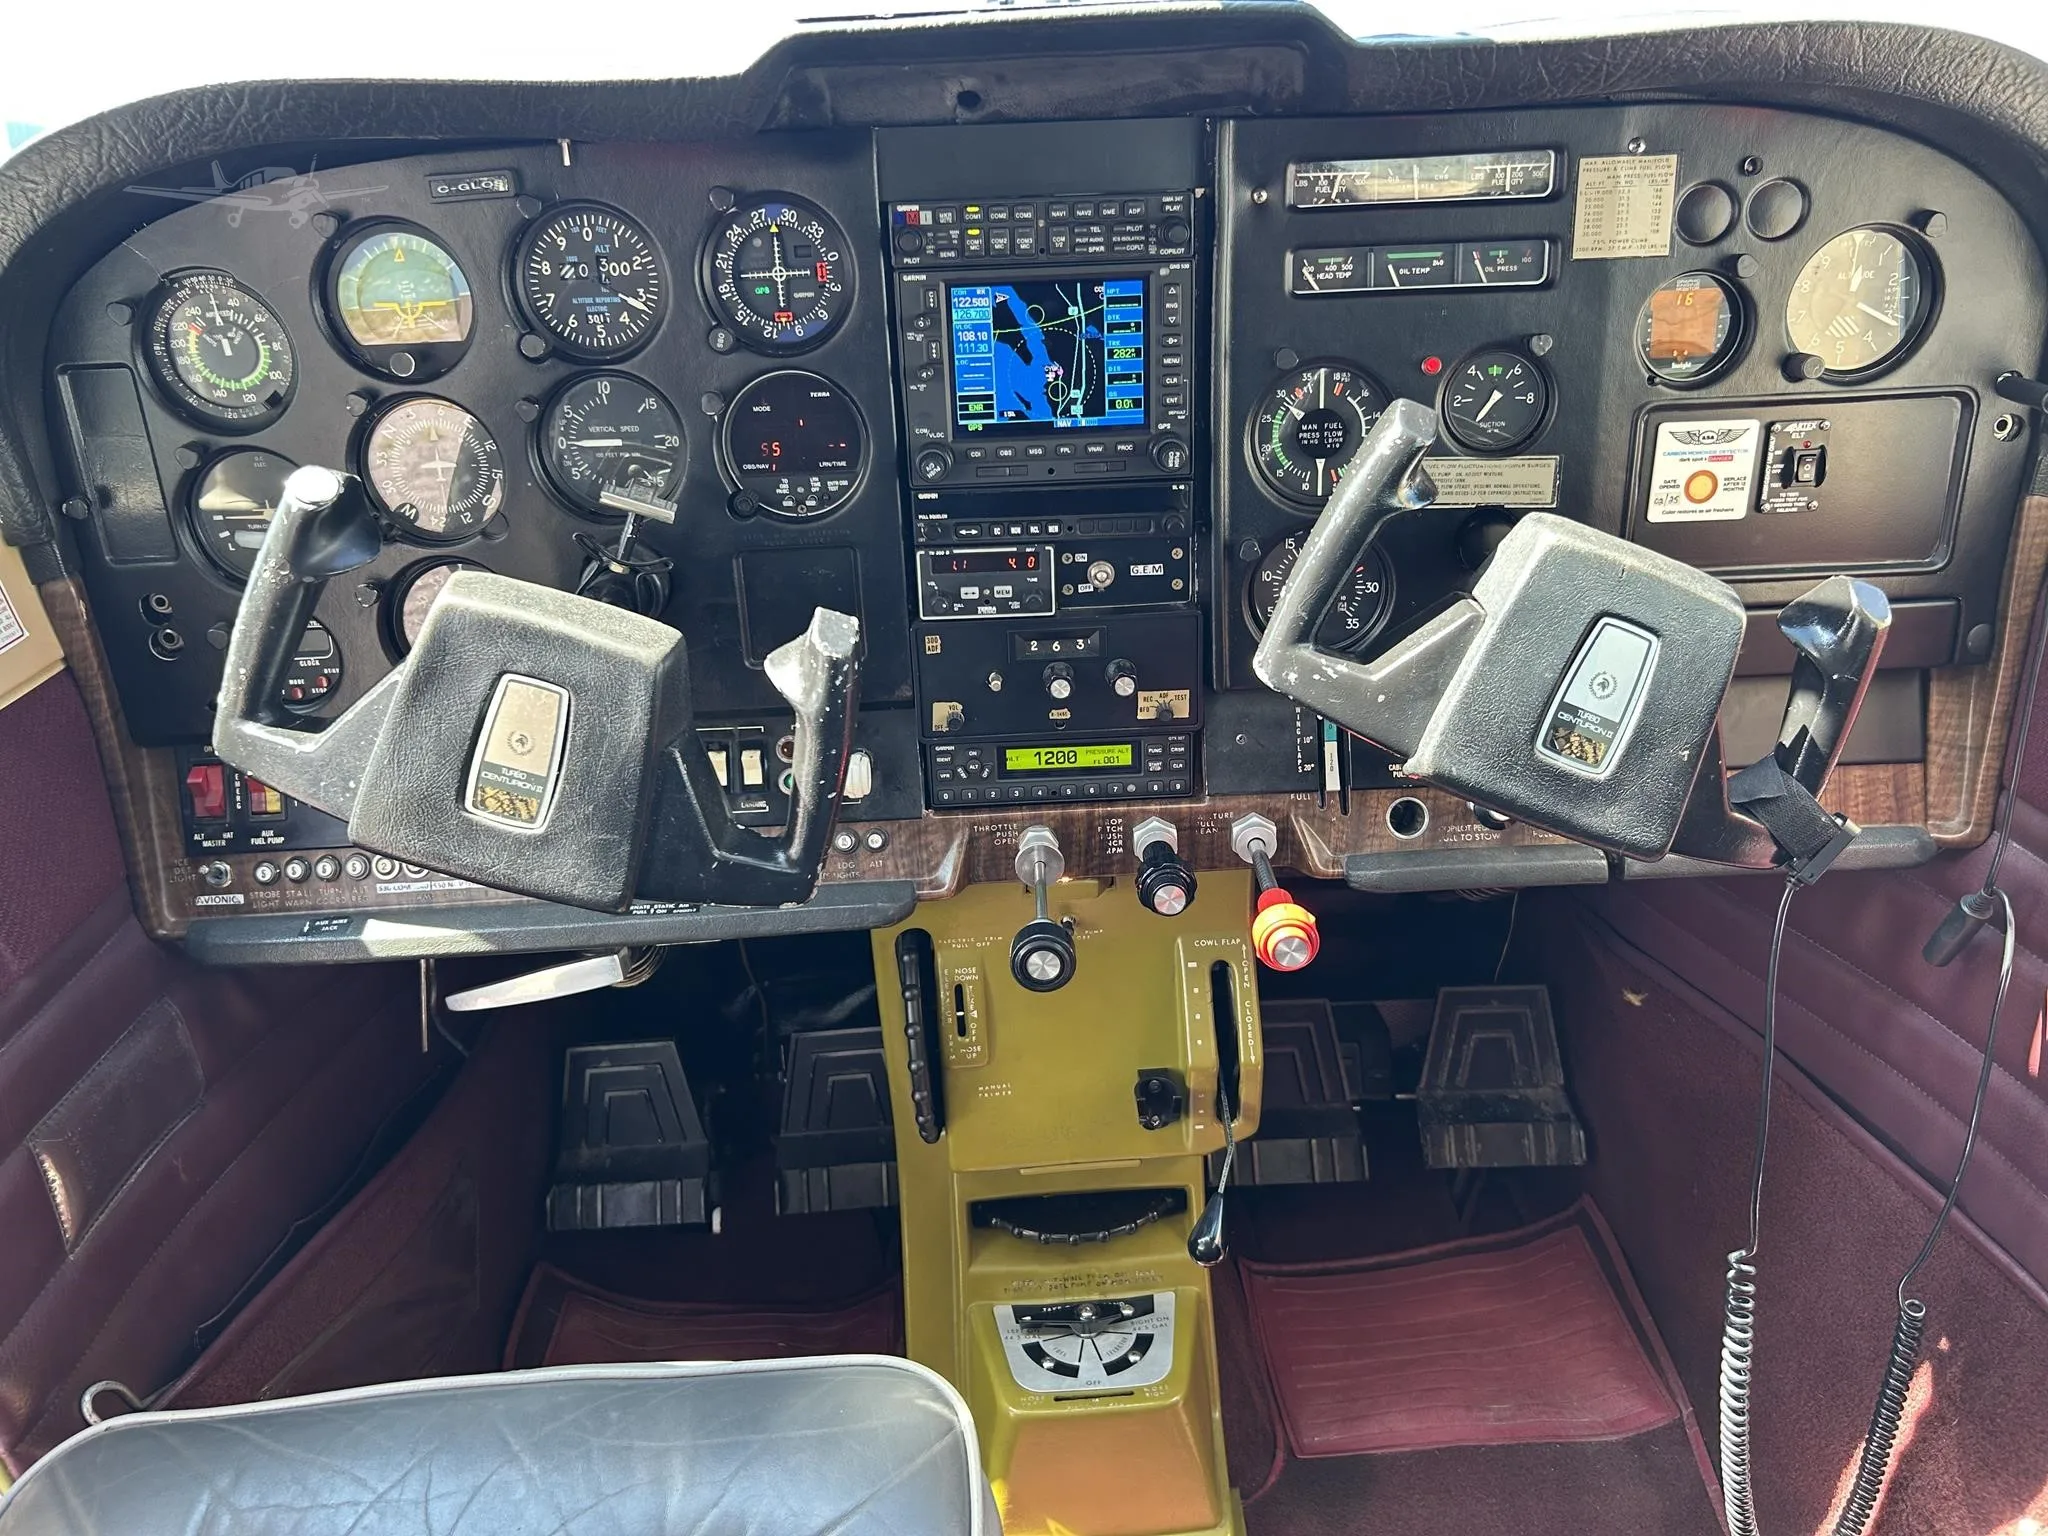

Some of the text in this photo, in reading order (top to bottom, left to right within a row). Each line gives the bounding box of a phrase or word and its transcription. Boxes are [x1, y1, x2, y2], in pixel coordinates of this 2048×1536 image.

[437, 177, 508, 193] C-GLO
[1128, 207, 1141, 215] ADF
[1165, 204, 1181, 212] PLAY
[750, 208, 766, 224] 27
[780, 208, 797, 222] 30
[582, 226, 592, 242] 0
[726, 223, 743, 242] 24
[807, 221, 825, 239] 33
[556, 237, 566, 251] 9
[614, 233, 619, 248] 1
[594, 244, 610, 254] ALT
[632, 256, 642, 270] 2
[715, 252, 728, 269] 21
[541, 261, 551, 275] 8
[1399, 267, 1410, 275] OIL
[636, 288, 647, 302] 3
[718, 283, 732, 301] 18
[754, 286, 770, 295] GPS
[545, 293, 555, 308] 7
[953, 297, 989, 307] 122.500
[1676, 292, 1694, 306] 16
[184, 306, 202, 317] 240
[954, 310, 990, 320] 126.700
[568, 313, 578, 328] 6
[619, 311, 630, 326] 4
[735, 310, 750, 326] 15
[173, 321, 188, 331] 220
[597, 325, 606, 339] 5
[763, 325, 778, 339] 12
[957, 331, 988, 341] 108.10
[958, 343, 988, 353] 111.30
[1302, 373, 1313, 381] 35
[1333, 372, 1341, 381] 18
[597, 381, 610, 394] 10
[1361, 389, 1369, 397] 16
[1276, 390, 1287, 398] 30
[645, 398, 657, 410] 15
[1261, 415, 1272, 423] 25
[484, 440, 497, 453] 12
[664, 435, 680, 447] 20
[376, 451, 388, 467] 33
[491, 469, 503, 480] 15
[382, 480, 396, 494] 30
[430, 516, 447, 528] 24
[460, 512, 473, 525] 21
[1285, 538, 1295, 549] 15
[1131, 565, 1162, 575] G.E.M
[1262, 571, 1272, 581] 10
[1365, 582, 1379, 593] 30
[1345, 618, 1359, 629] 35
[1577, 709, 1600, 724] TURBO
[1557, 711, 1608, 737] CENTURION
[1034, 750, 1077, 766] 1200
[1103, 756, 1120, 764] 001
[501, 767, 527, 779] TURBO
[481, 771, 537, 791] CENTURION
[234, 773, 242, 810] EMERG
[973, 823, 1018, 832] THROTTLE
[994, 838, 1019, 846] OPEN
[1461, 832, 1501, 842] TO STOW
[202, 839, 226, 847] MASTER
[869, 860, 883, 868] ALT
[250, 890, 280, 899] STROBE
[286, 889, 312, 898] STALL
[252, 900, 279, 909] LIGHT
[285, 899, 312, 907] WARN
[1194, 938, 1241, 947] COWL FLAP
[954, 974, 979, 982] DOWN
[1241, 960, 1251, 989] OPEN
[1244, 1000, 1255, 1046] CLOSED
[978, 1083, 1012, 1091] MANUAL
[1130, 1318, 1155, 1326] RIGHT
